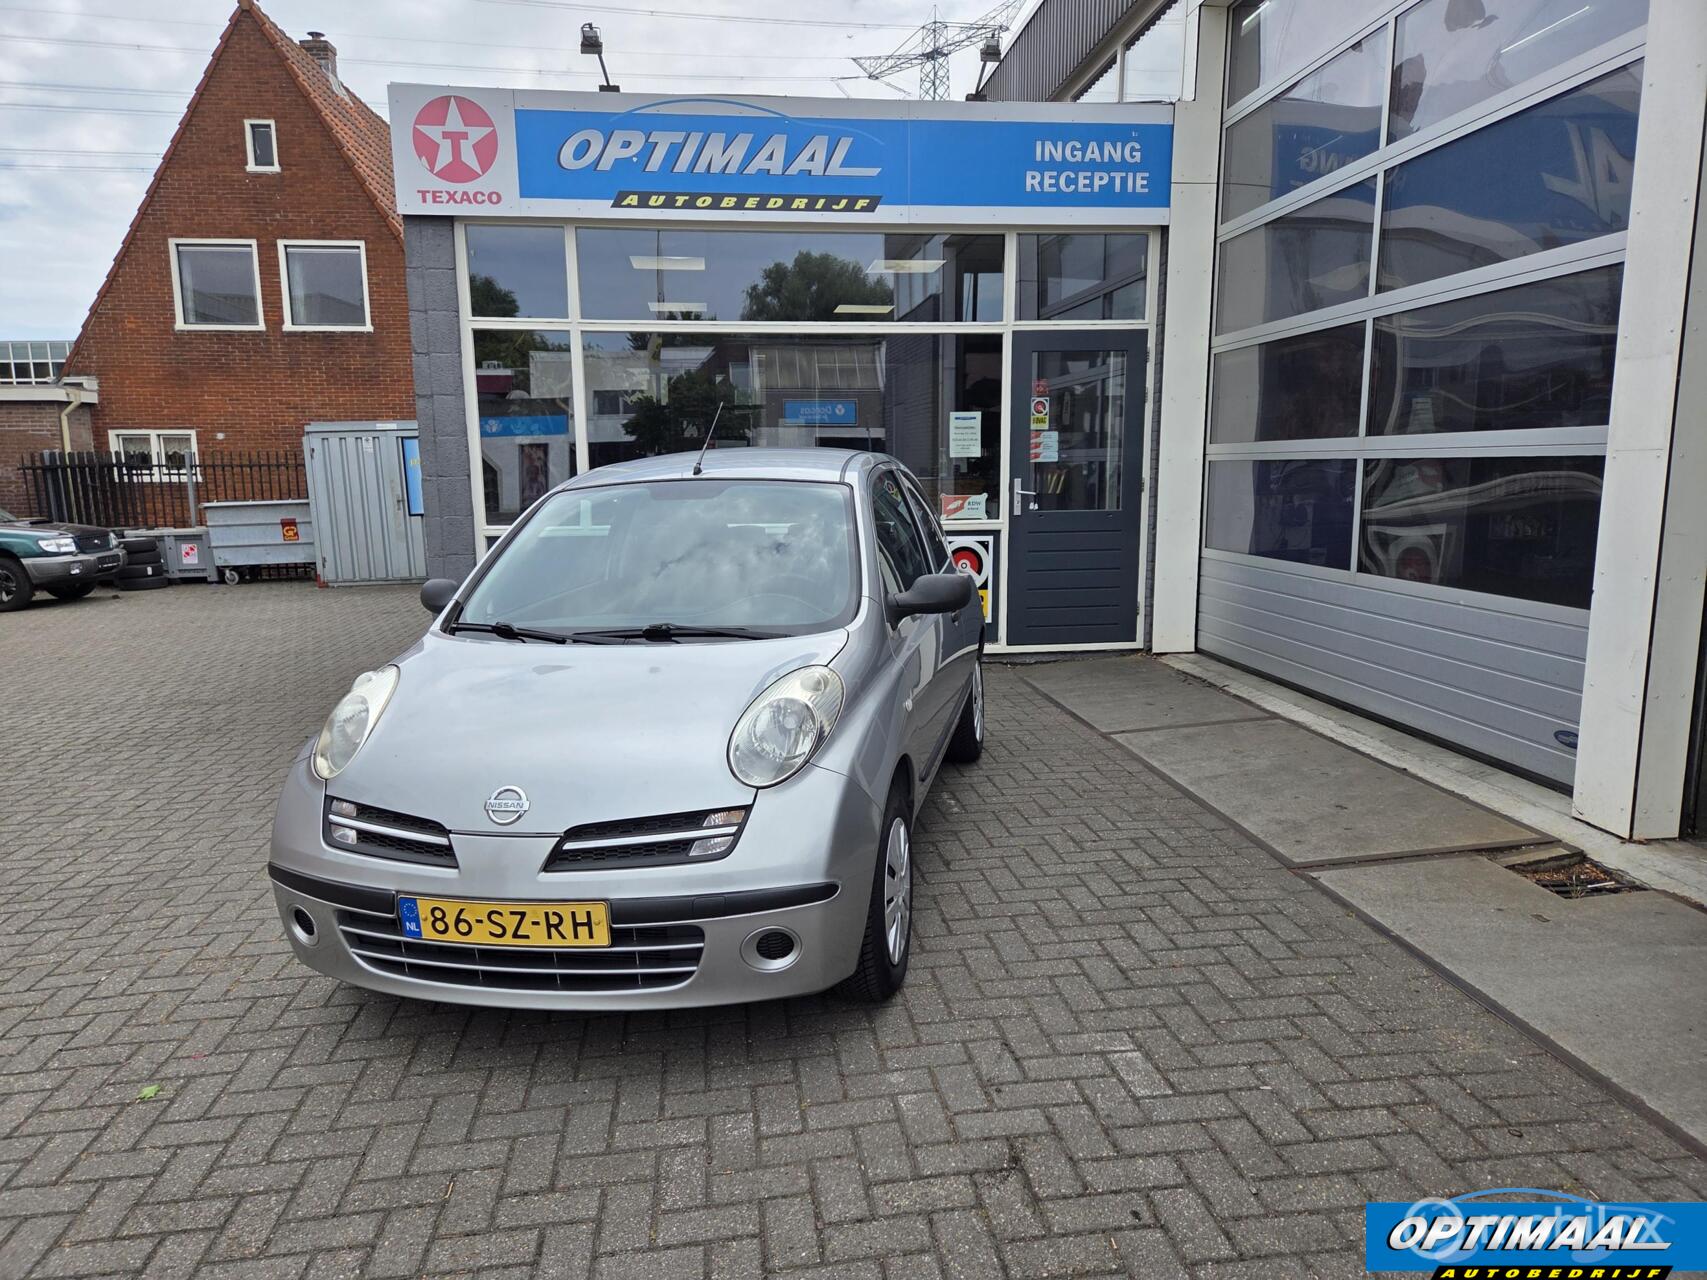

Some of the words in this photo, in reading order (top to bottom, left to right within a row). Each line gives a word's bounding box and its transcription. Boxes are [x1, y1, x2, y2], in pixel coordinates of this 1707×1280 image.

[557, 128, 882, 177] OPTIMAAL
[1035, 140, 1142, 163] INGANG
[1025, 171, 1149, 193] RECEPTIE
[416, 189, 502, 205] TEXACO
[621, 194, 870, 210] AUTOBEDRIJF
[487, 801, 525, 809] NISSAN
[406, 921, 420, 933] NL
[430, 905, 595, 940] 86-SZ-RH
